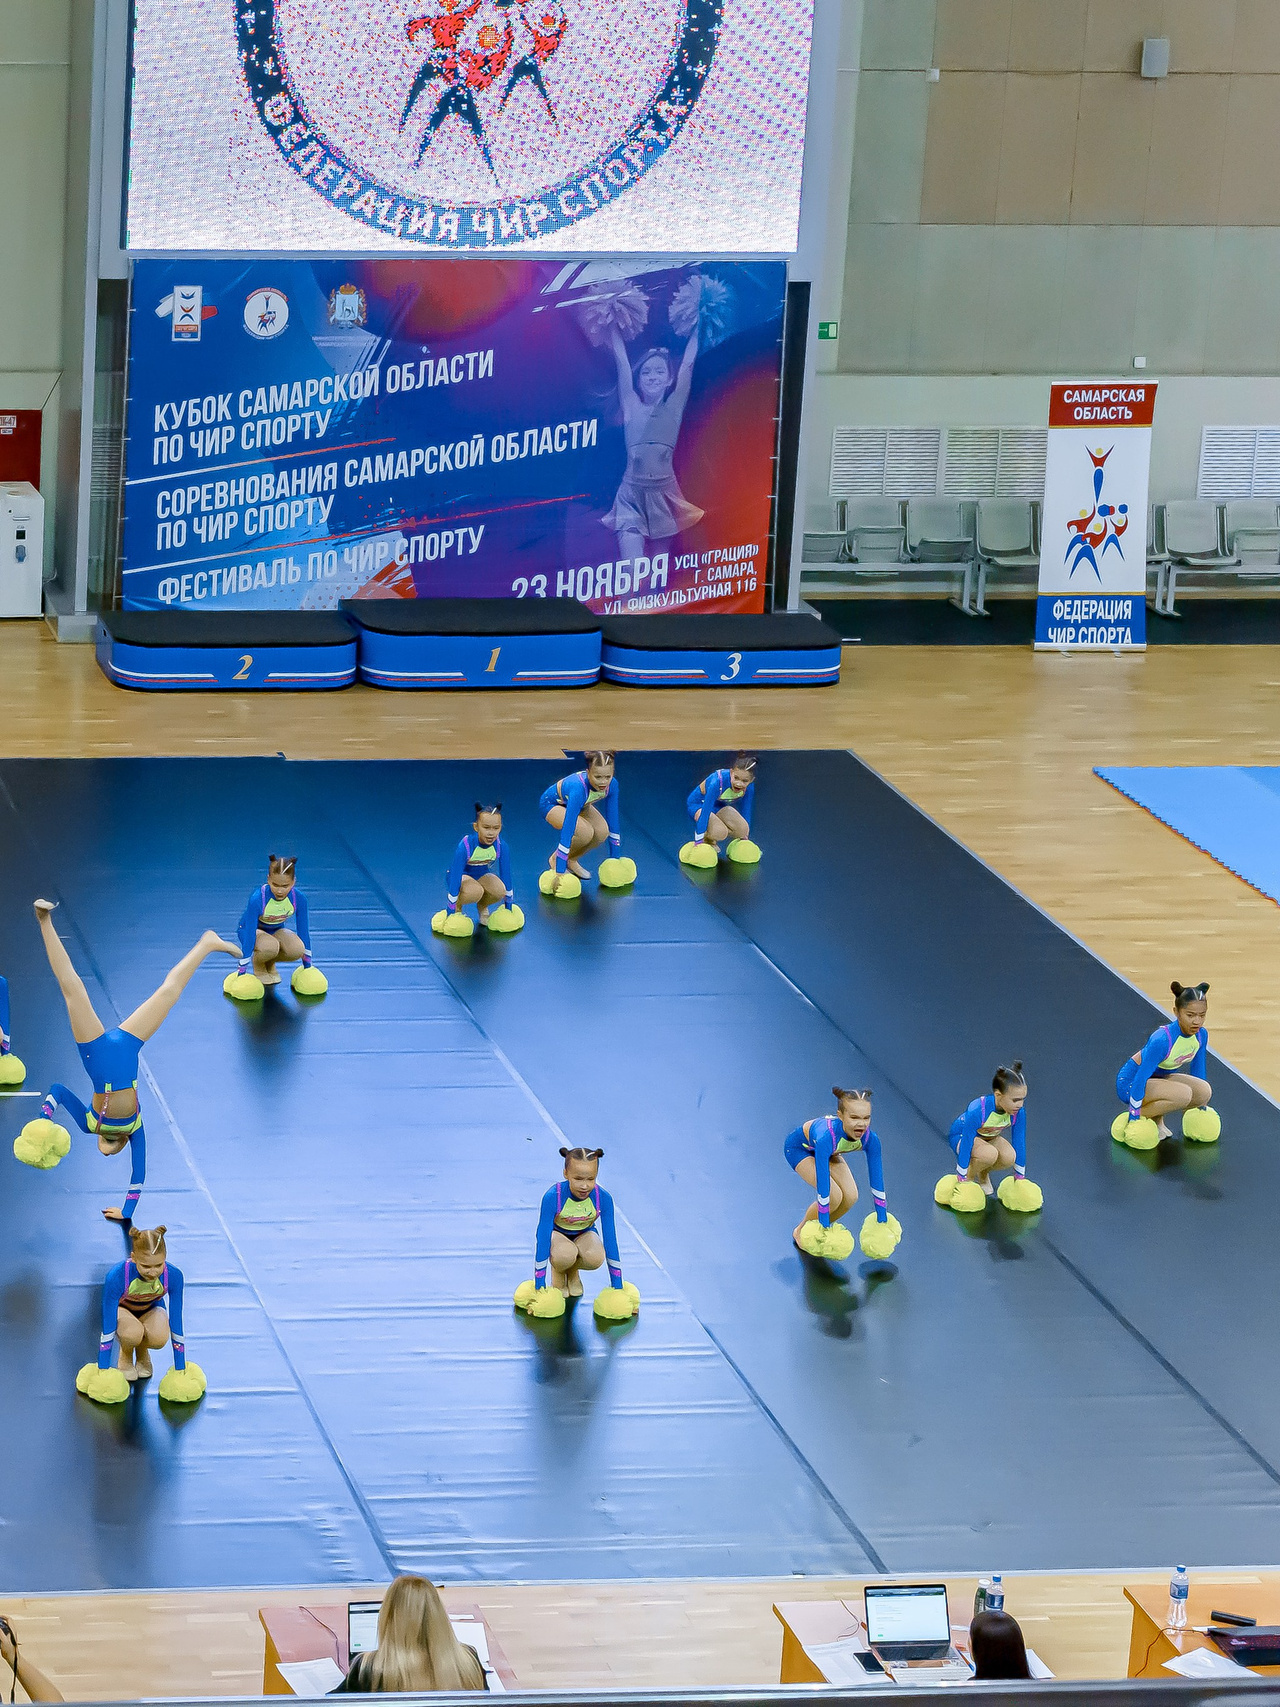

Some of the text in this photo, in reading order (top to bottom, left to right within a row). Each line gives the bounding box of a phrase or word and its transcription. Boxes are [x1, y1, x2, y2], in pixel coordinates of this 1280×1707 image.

[471, 200, 549, 242] ЧИР
[154, 349, 494, 433] КУБОК САМАРСКОЙ ОБЛАСТИ
[1063, 389, 1145, 404] САМАРСКАЯ
[1074, 406, 1133, 421] ОБЛАСТЬ
[153, 408, 333, 465] ПО ЧИР СПОРТУ
[156, 418, 598, 519] СОРЕВНОВАНИЯ САМАРСКОЙ ОБЛАСТИ
[156, 494, 335, 550] ПО ЧИР СПОРТУ
[157, 524, 485, 605] ФЕСТИВАЛЬ ПО ЧИР СПОРТУ
[674, 544, 759, 571] УСЦ «ГРАЦИЯ»
[511, 553, 669, 602] 23 НОЯБРЯ
[694, 560, 758, 584] Г. САМАРА,
[627, 584, 734, 612] ФИЗКУЛЬТУРНАЯ,
[737, 577, 757, 594] 116
[1052, 599, 1132, 624] ФЕДЕРАЦИЯ
[1048, 626, 1132, 644] ЧИР СПОРТА
[232, 655, 253, 680] 2
[484, 647, 501, 672] 1
[720, 652, 742, 680] 3
